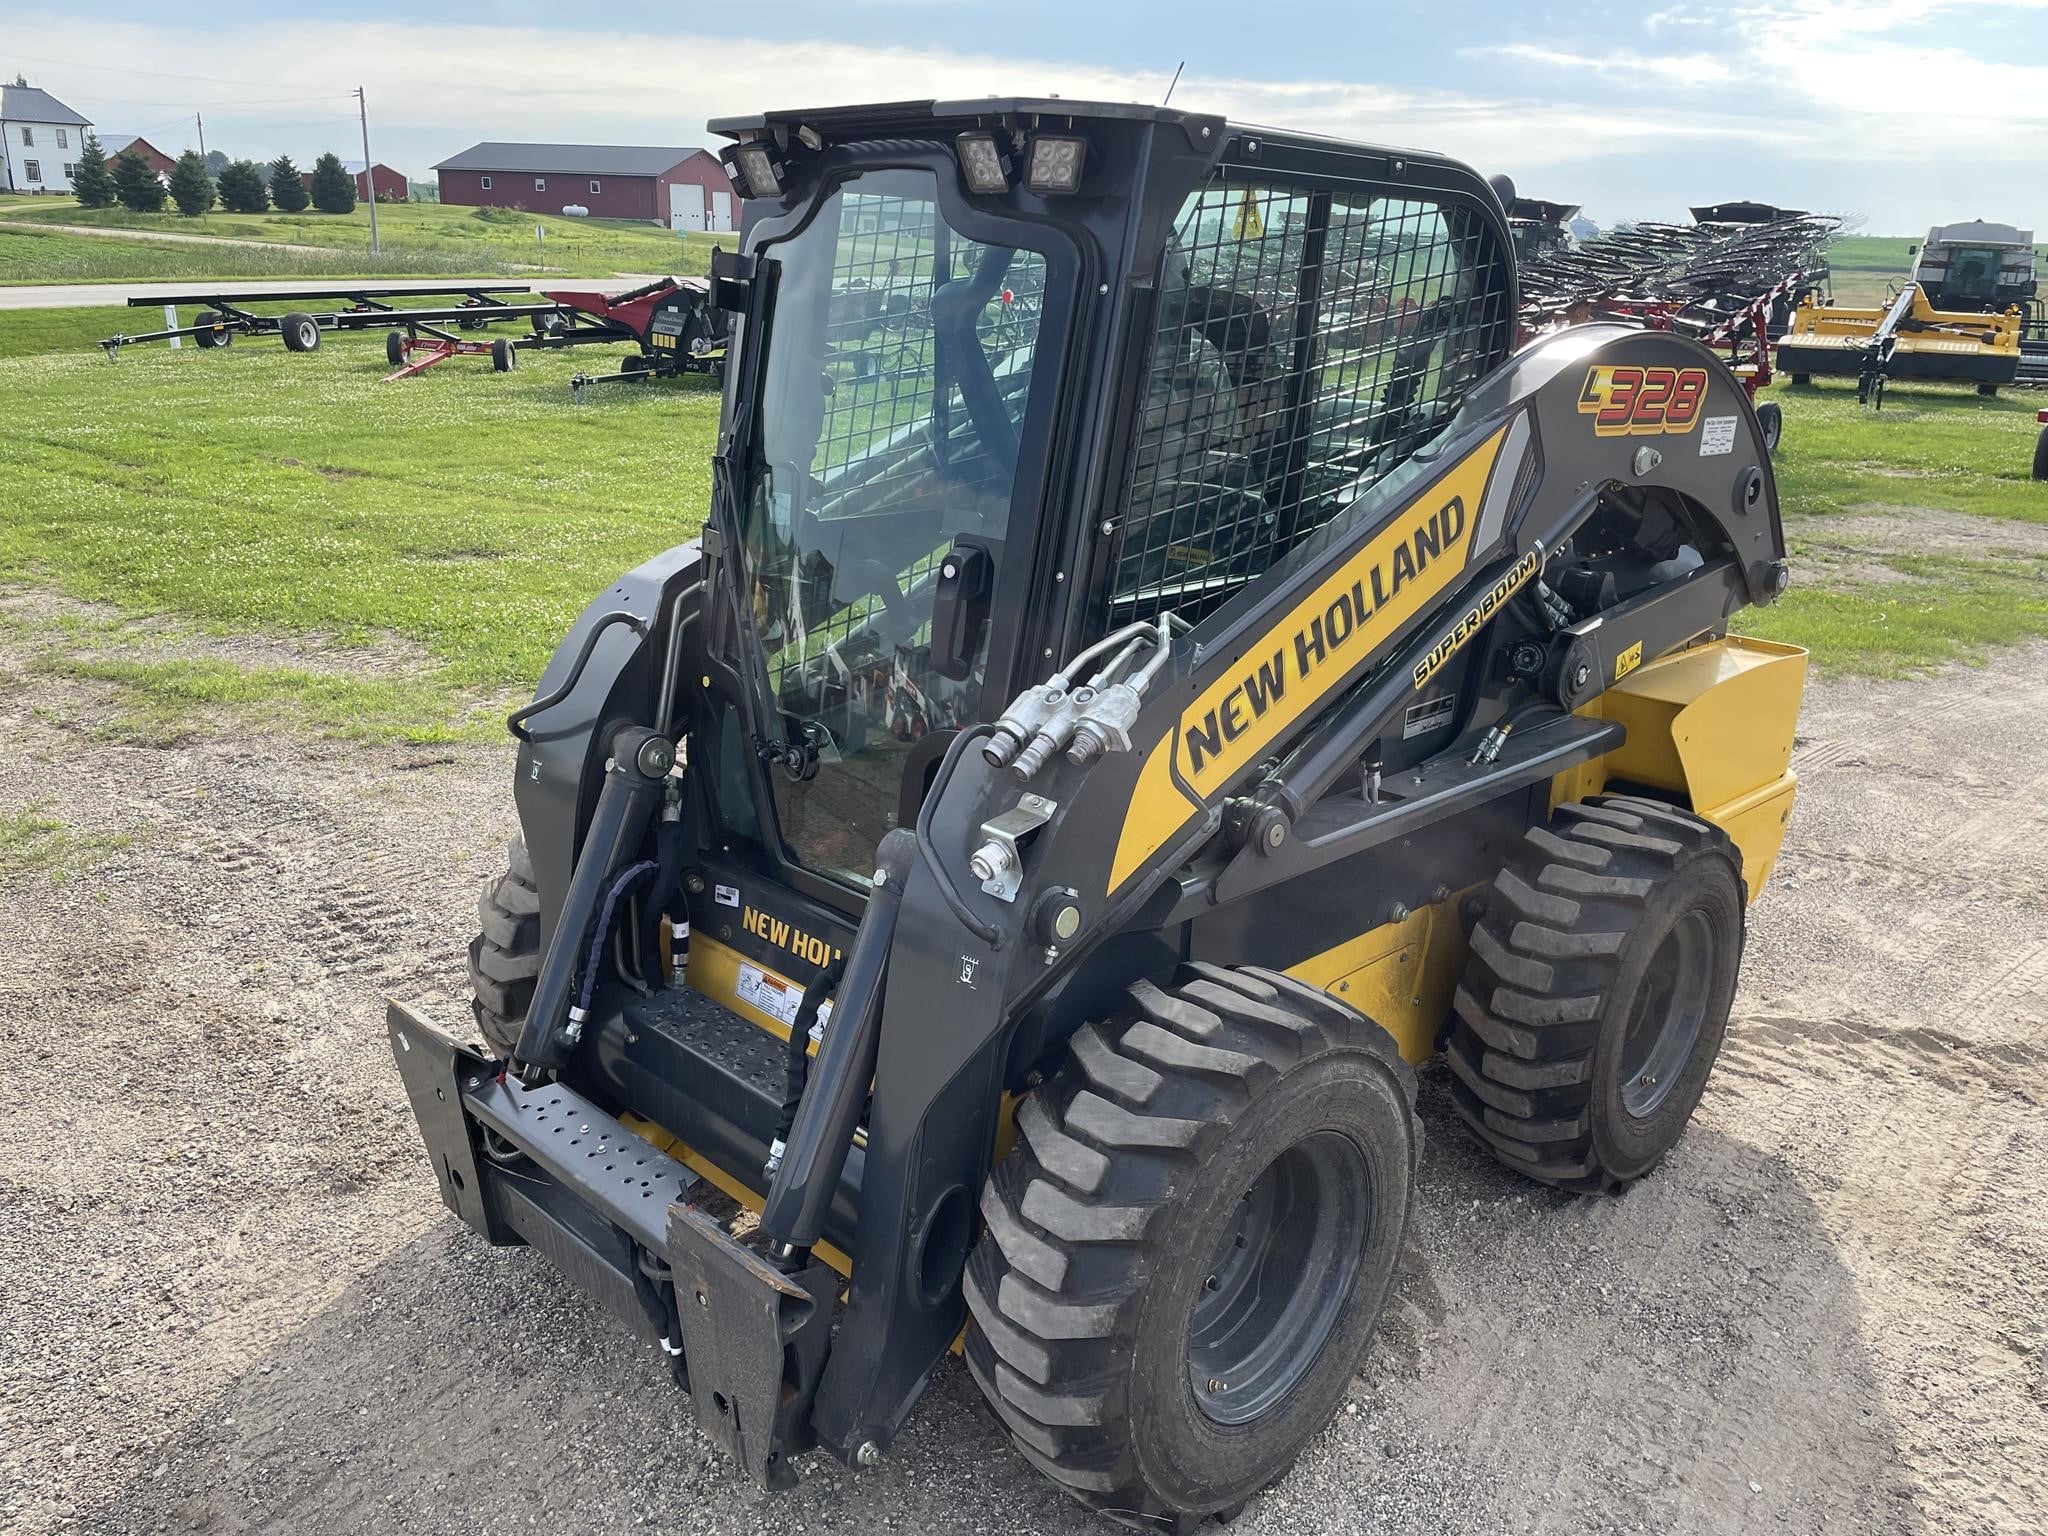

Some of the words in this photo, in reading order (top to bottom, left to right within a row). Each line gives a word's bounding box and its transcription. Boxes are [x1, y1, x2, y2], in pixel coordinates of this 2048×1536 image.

[1579, 367, 1707, 430] L328
[1184, 647, 1286, 777] NEW
[1291, 494, 1466, 680] HOLLAND
[1413, 609, 1480, 688] SUPER
[1481, 553, 1536, 620] BOOM
[742, 905, 790, 949] NEW
